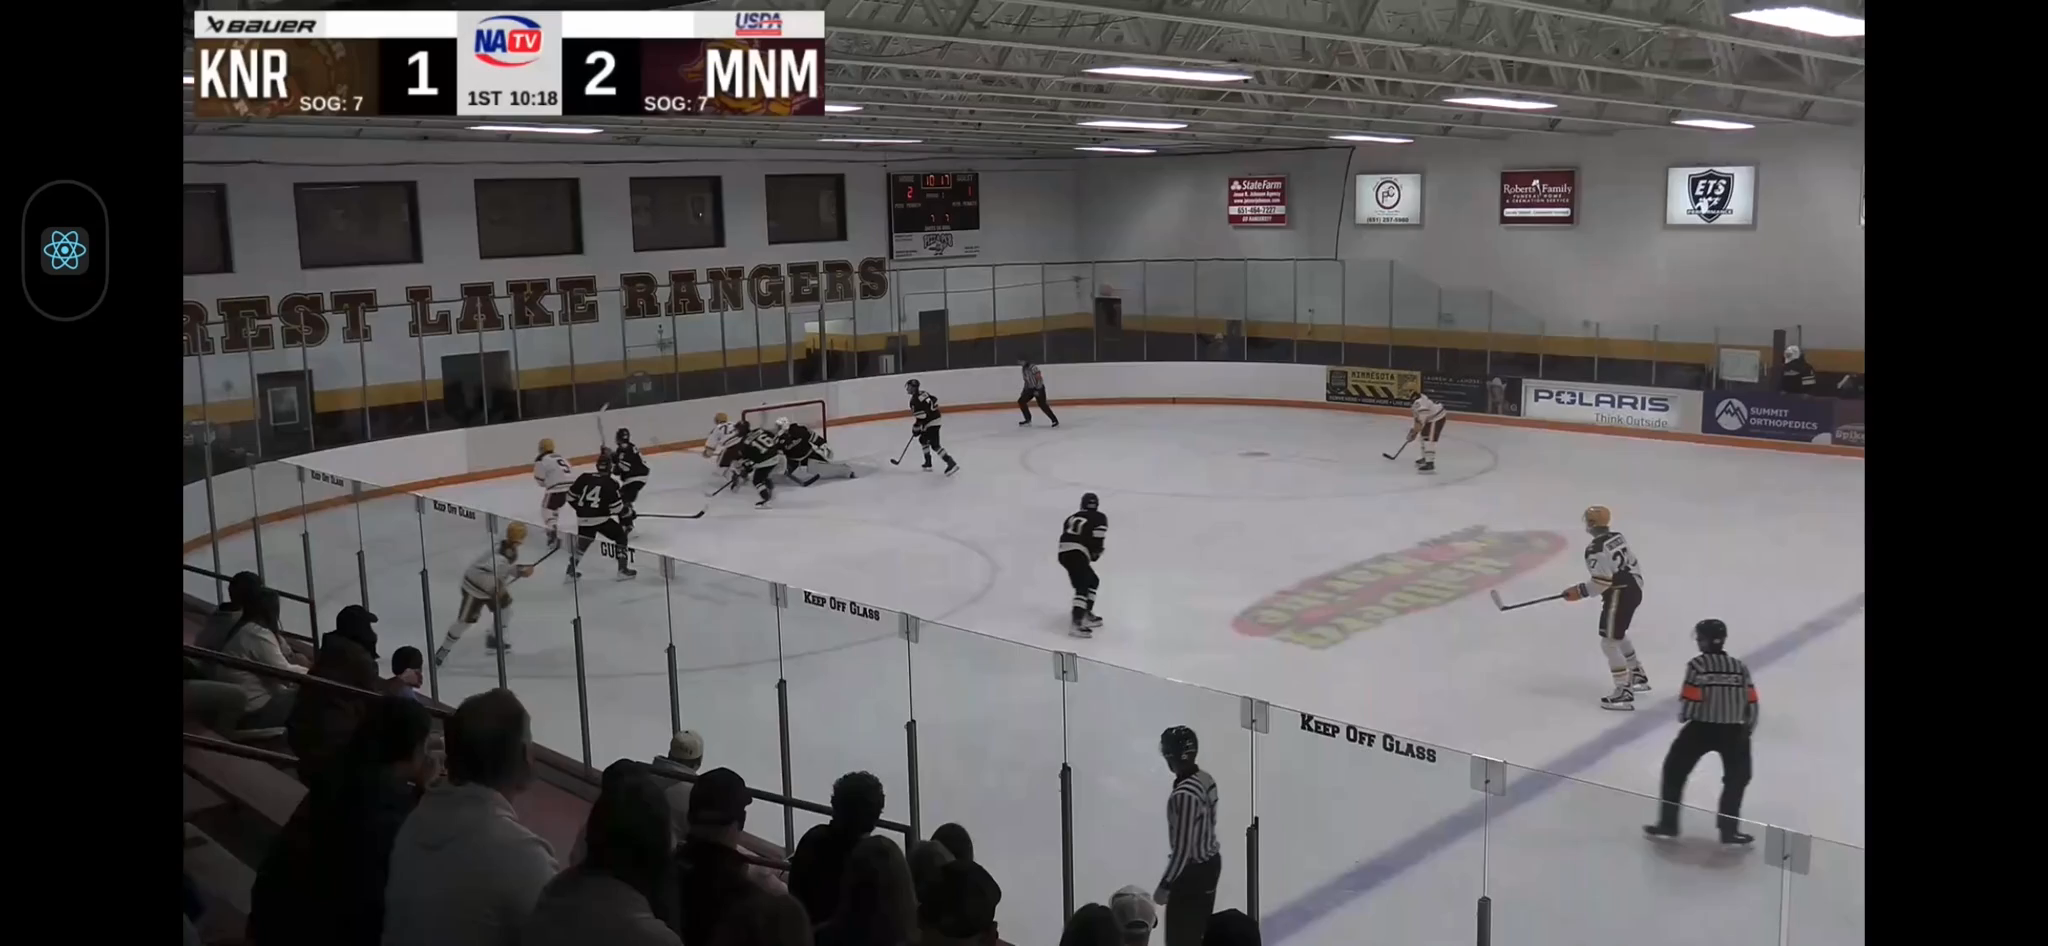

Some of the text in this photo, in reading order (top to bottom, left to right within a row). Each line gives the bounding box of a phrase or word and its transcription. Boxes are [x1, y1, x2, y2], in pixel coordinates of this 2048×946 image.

[1503, 183, 1573, 194] Roberts Family
[1694, 179, 1727, 195] ETS
[406, 275, 599, 337] LAKE
[620, 257, 889, 319] RANGERS
[1351, 371, 1395, 380] MINNESOTA
[1534, 389, 1670, 412] POLARIS
[1750, 407, 1789, 417] SUMMIT
[1594, 413, 1668, 428] Think Outside
[1749, 418, 1819, 430] ORTHOPEDICS
[577, 484, 602, 508] 14
[601, 541, 635, 563] GUEST
